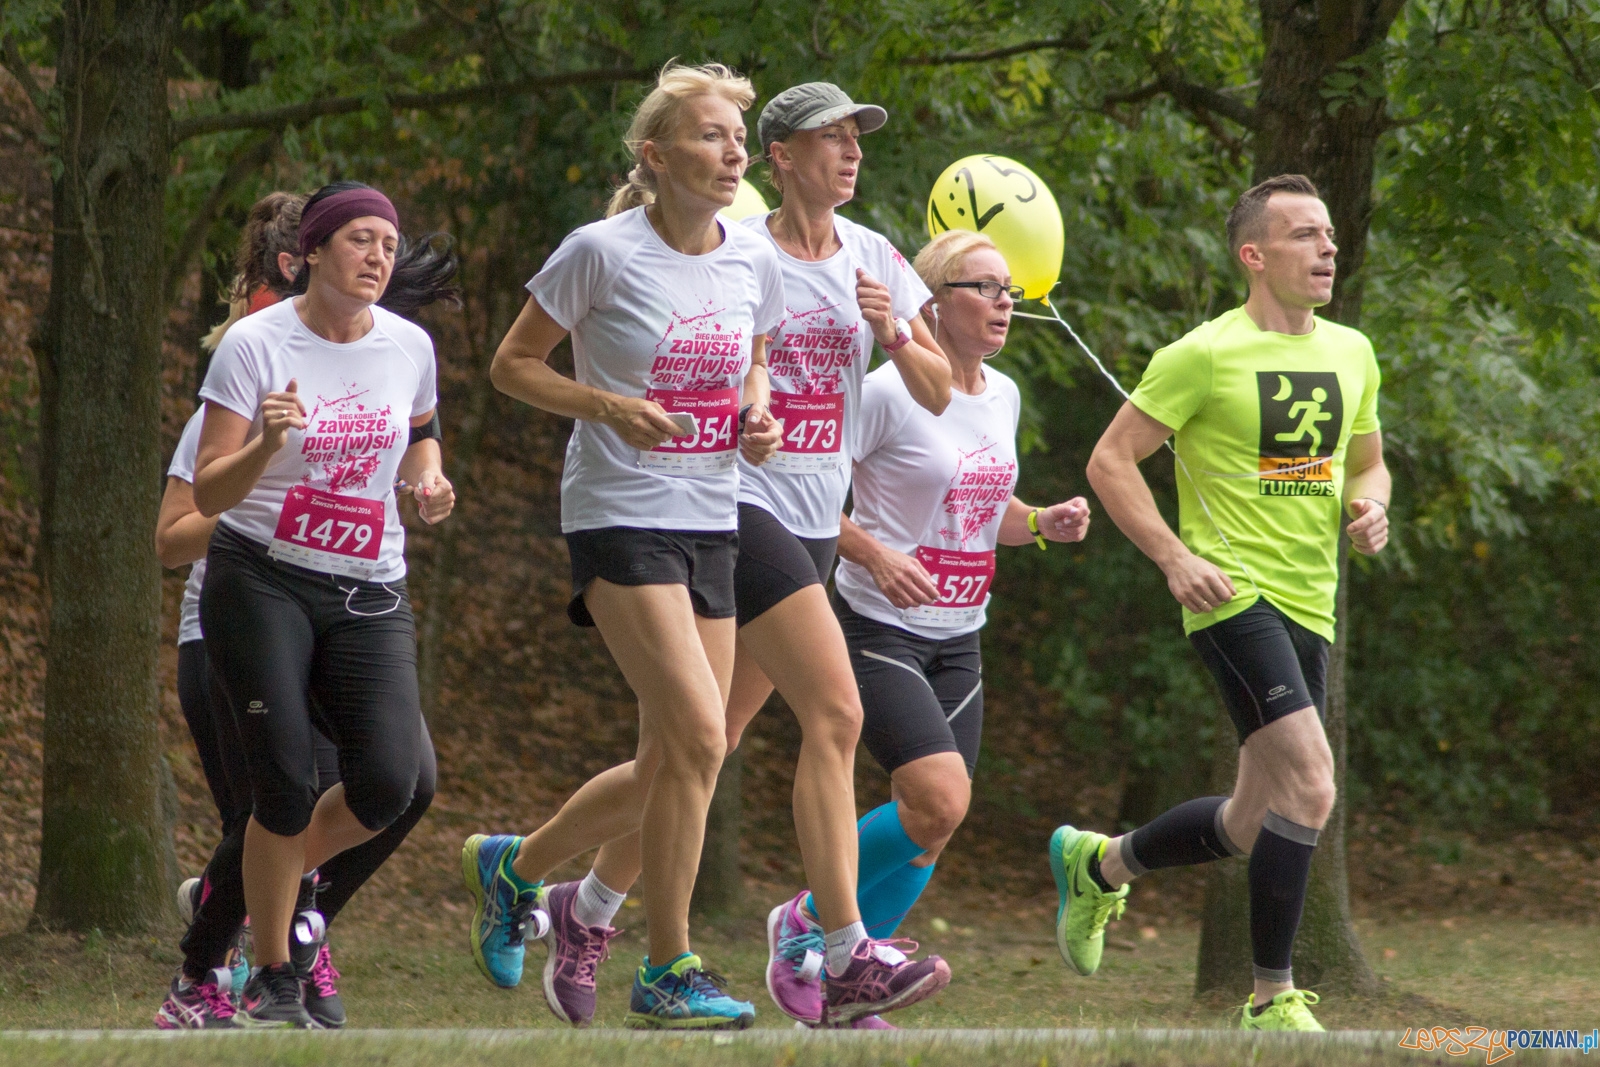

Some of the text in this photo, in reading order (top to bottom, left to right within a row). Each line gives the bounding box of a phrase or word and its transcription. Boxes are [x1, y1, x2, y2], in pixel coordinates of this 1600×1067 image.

[711, 333, 732, 341] KOBIET
[782, 333, 852, 350] zawsze
[669, 339, 739, 357] zawsze
[650, 355, 744, 379] pier(w)si!
[768, 349, 856, 373] pier(w)si!
[654, 372, 685, 384] 2016
[772, 365, 802, 377] 2016
[317, 418, 387, 433] zawsze
[301, 431, 396, 455] pier(w)si!
[305, 452, 335, 462] 2016
[1278, 458, 1323, 479] night
[960, 472, 1012, 486] zawsze
[942, 486, 1009, 506] pier(w)si
[1260, 480, 1335, 496] runners
[945, 503, 966, 514] 2016
[291, 513, 372, 553] 1479
